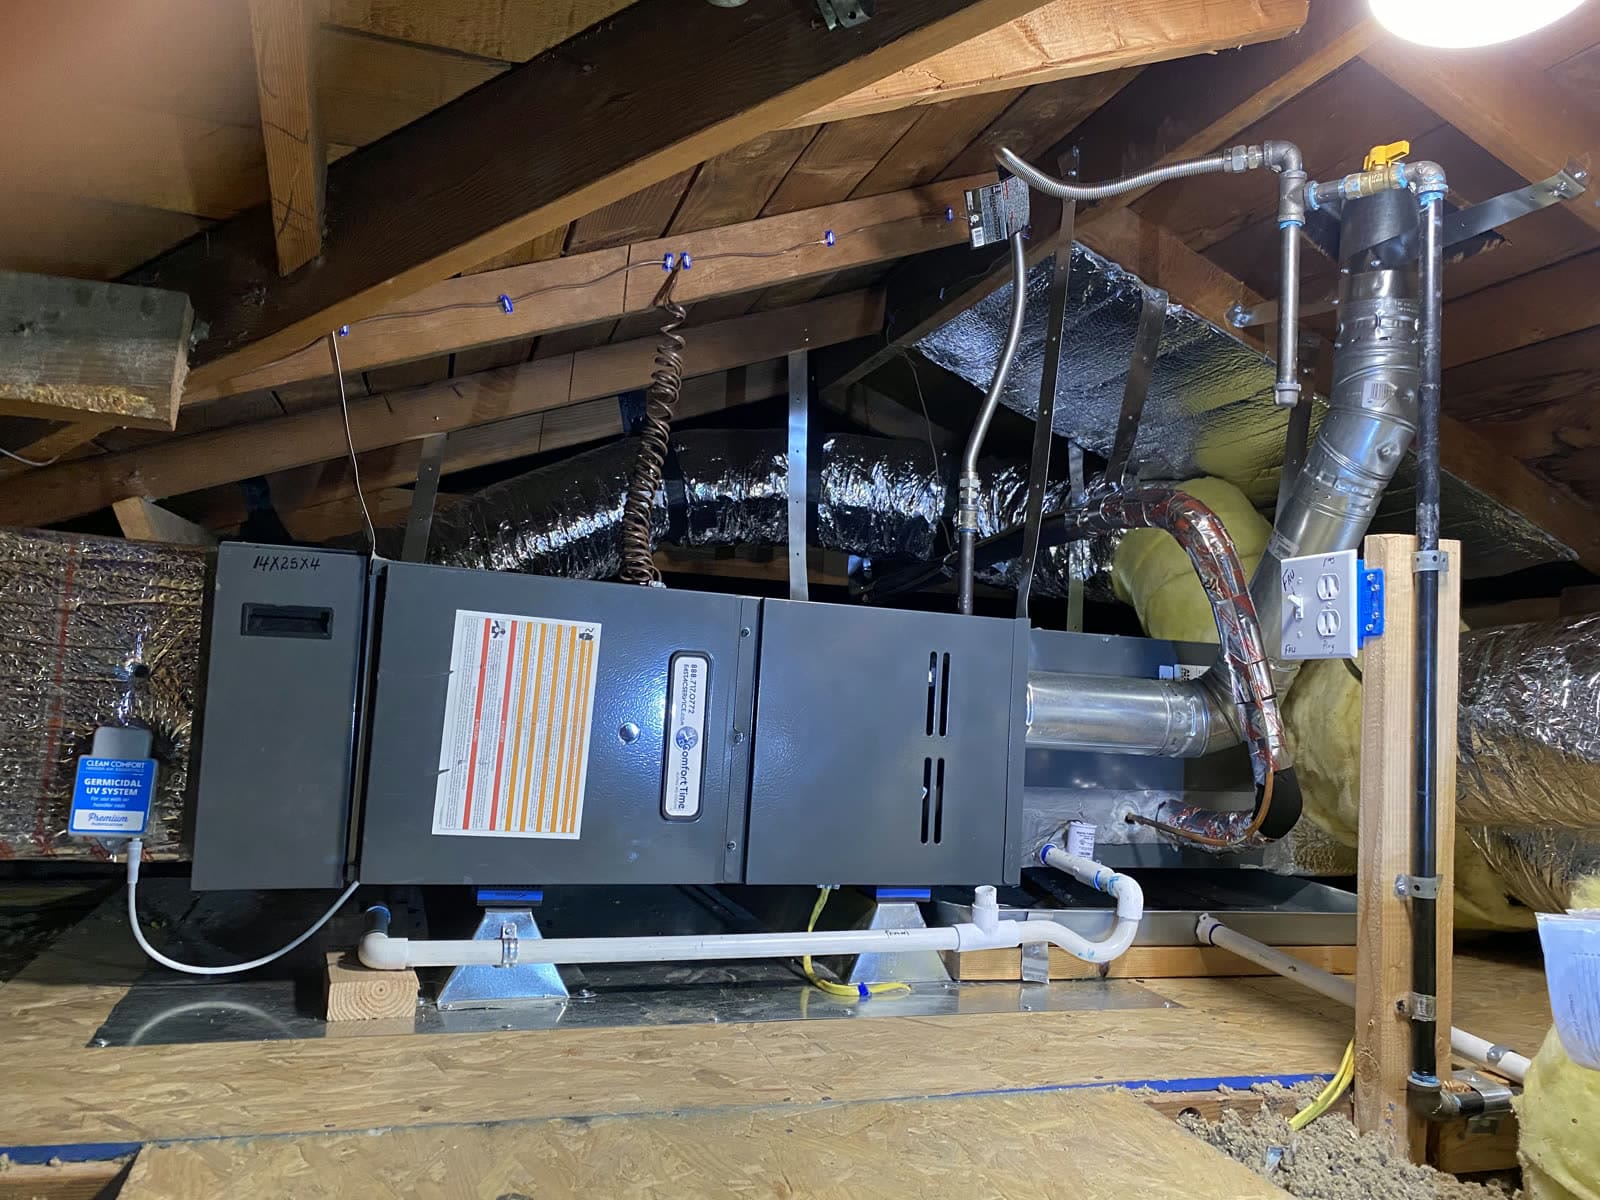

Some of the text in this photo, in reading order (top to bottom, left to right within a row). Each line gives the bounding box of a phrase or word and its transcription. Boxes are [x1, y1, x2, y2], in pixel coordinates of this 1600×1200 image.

[687, 663, 698, 715] 888.717.0772
[110, 761, 145, 769] COMFORT
[678, 743, 691, 809] Comfort Time
[84, 778, 142, 787] GERMICIDAL
[86, 787, 138, 796] UV SYSTEM
[88, 812, 129, 823] Premium
